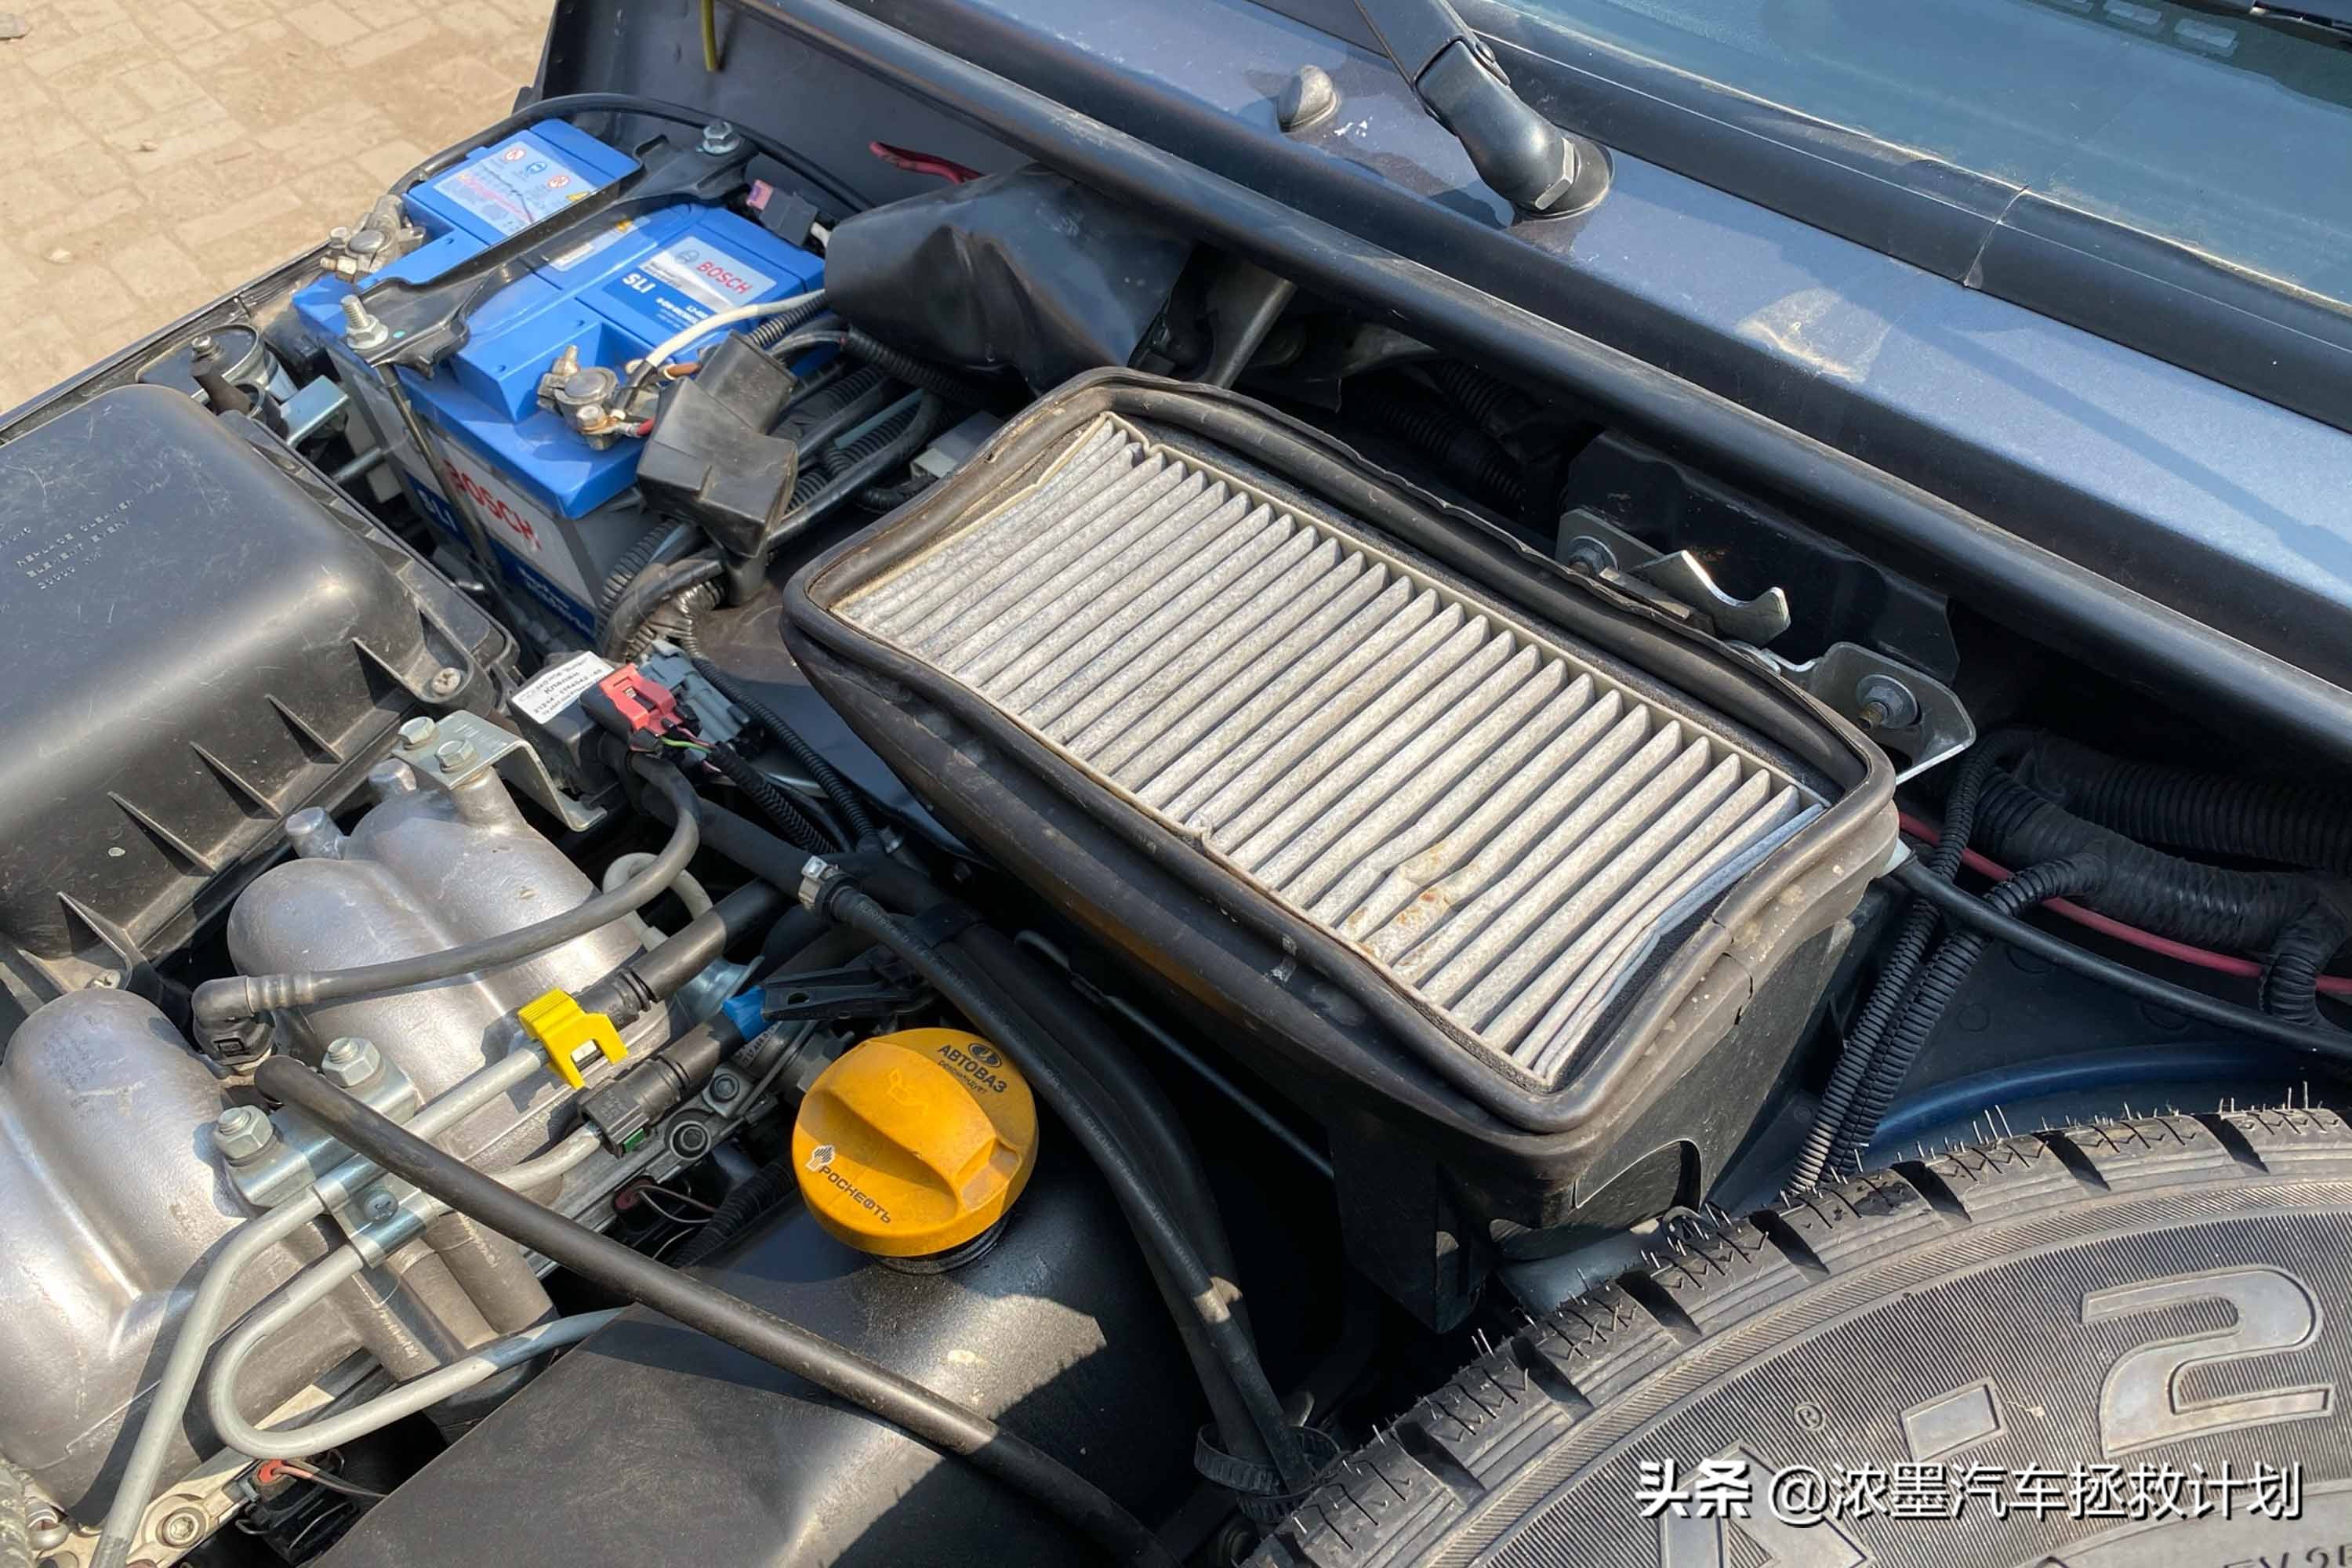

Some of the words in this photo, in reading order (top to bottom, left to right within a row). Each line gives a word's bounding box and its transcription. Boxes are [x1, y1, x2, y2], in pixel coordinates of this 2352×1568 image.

[622, 272, 657, 295] SLI
[696, 260, 753, 295] BOSCH
[937, 1044, 1007, 1093] АВТОВАЗ
[818, 1165, 891, 1224] РОСНЕФТЬ
